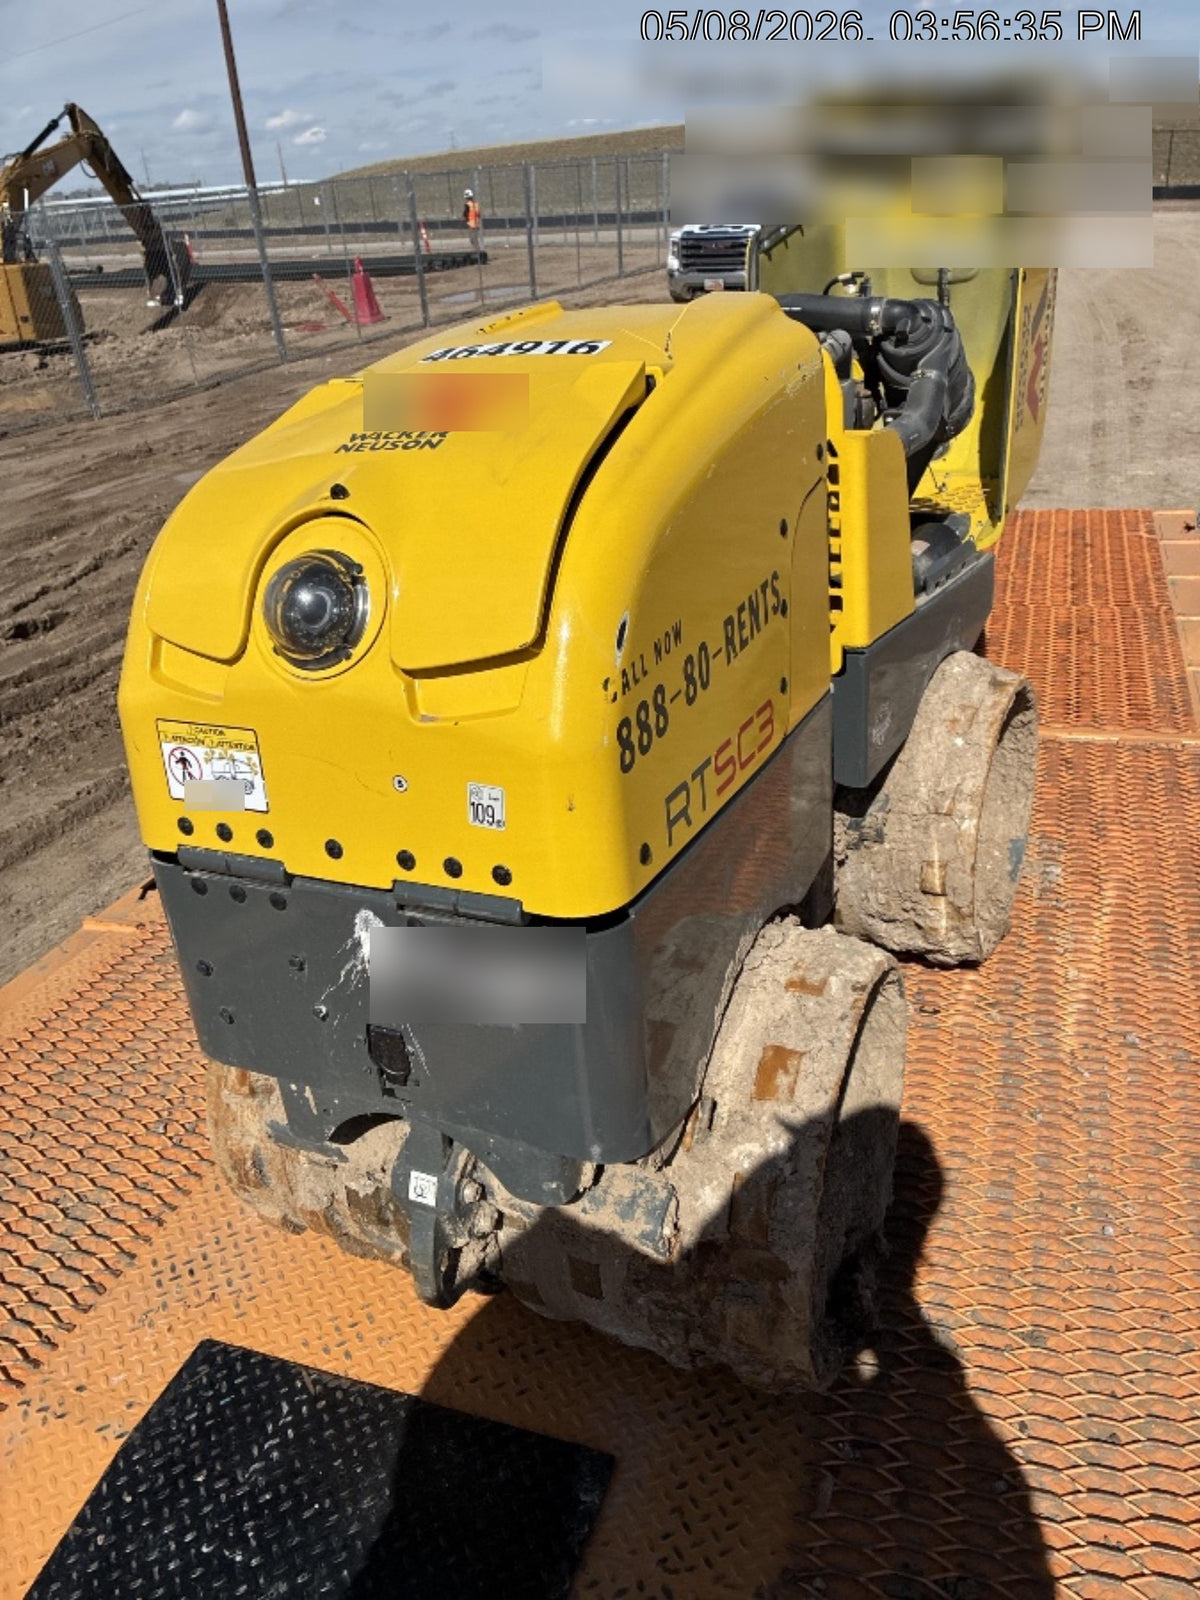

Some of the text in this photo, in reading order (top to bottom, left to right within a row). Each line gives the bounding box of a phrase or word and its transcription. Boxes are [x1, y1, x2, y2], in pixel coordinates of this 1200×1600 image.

[422, 340, 606, 362] 464916
[334, 438, 445, 454] NEUSON
[349, 430, 449, 443] WACKER
[653, 618, 683, 666] NOW
[616, 570, 780, 775] 888-80-RENTS
[664, 699, 775, 847] RTSC3
[470, 801, 495, 826] 109
